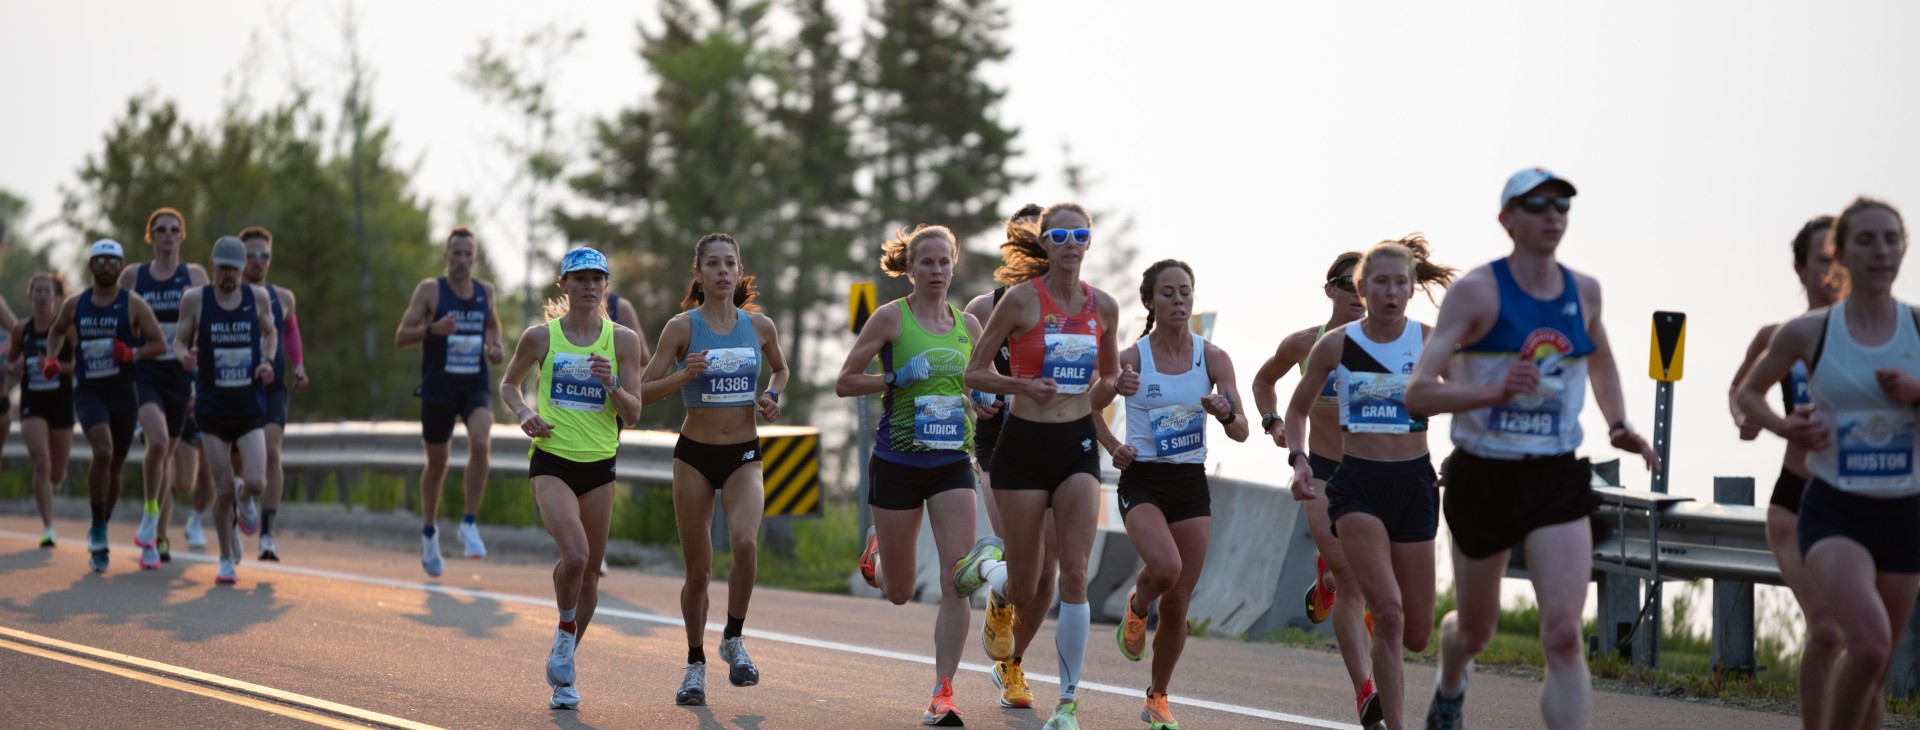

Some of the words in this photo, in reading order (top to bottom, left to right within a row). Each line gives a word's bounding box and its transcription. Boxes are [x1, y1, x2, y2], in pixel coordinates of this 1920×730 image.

[80, 317, 97, 326] MILL
[100, 317, 118, 326] CITY
[211, 322, 230, 332] MILL
[232, 321, 251, 331] CITY
[211, 332, 251, 343] RUNNING
[932, 362, 963, 372] arathon
[1053, 366, 1086, 379] EARLE
[555, 382, 563, 394] S
[566, 384, 603, 398] CLARK
[710, 376, 749, 392] 14386
[1361, 405, 1397, 418] GRAM
[923, 423, 958, 435] LUDICK
[1160, 439, 1169, 451] S
[1171, 432, 1201, 449] SMITH
[1846, 452, 1907, 471] HUSTON
